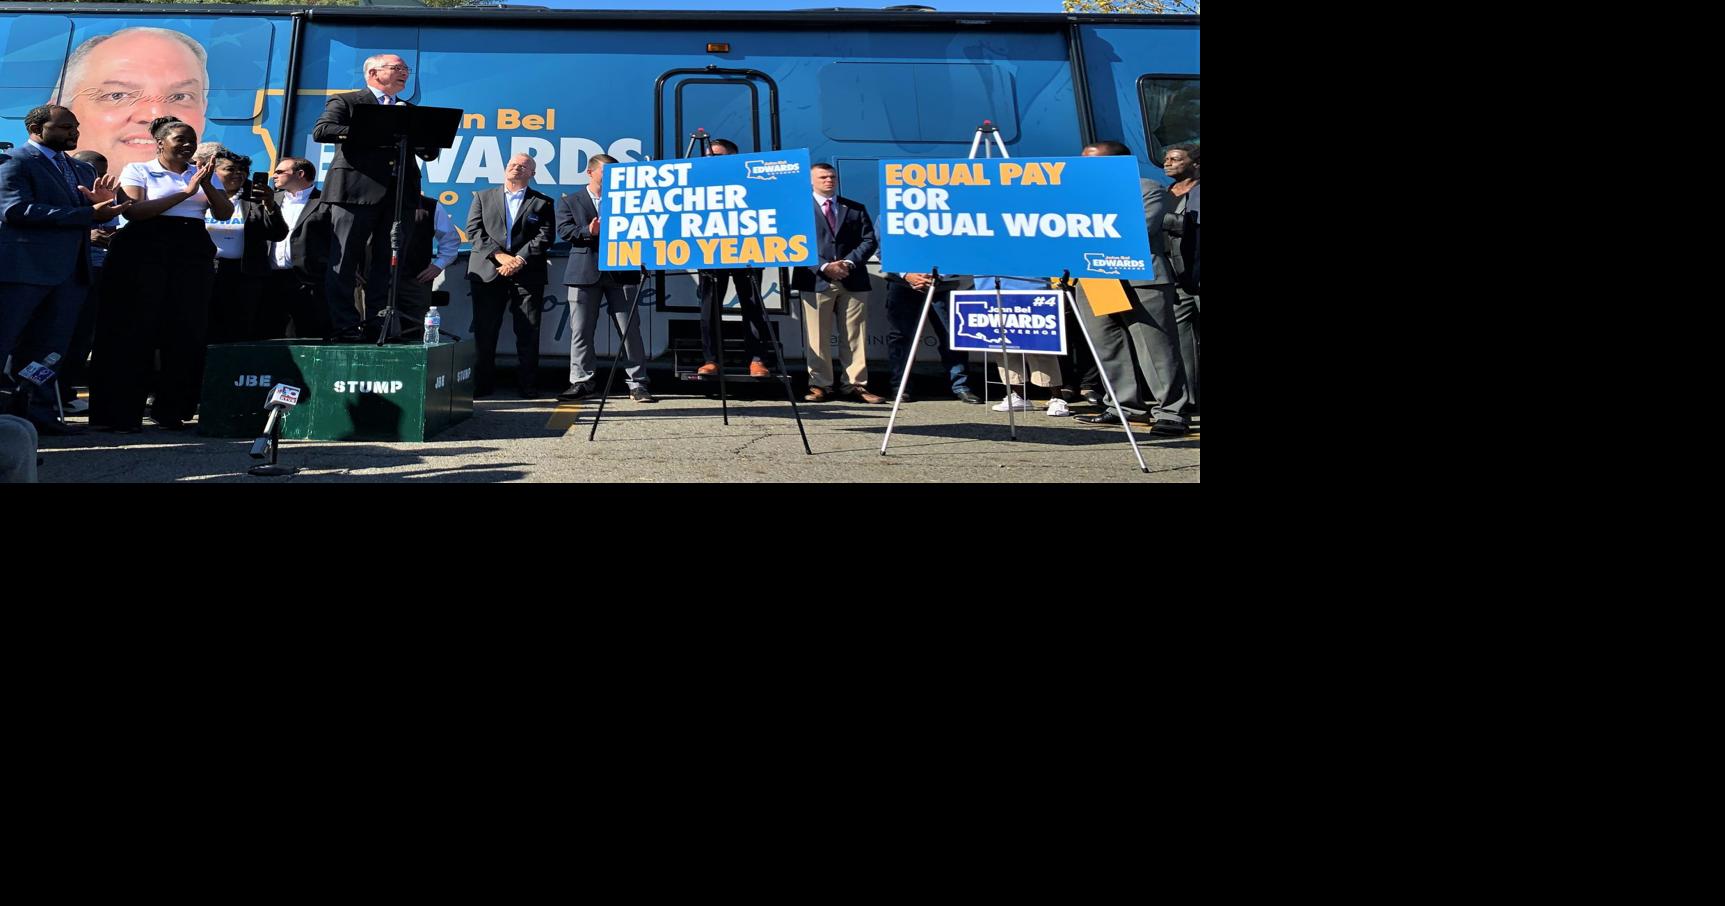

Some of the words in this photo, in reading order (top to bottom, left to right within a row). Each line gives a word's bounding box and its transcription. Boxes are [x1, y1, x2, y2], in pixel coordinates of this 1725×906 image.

[497, 108, 555, 130] Bel
[610, 163, 692, 190] FIRST
[753, 163, 799, 173] EDWARDS
[885, 163, 991, 188] EQUAL
[999, 162, 1066, 186] PAY
[608, 184, 748, 214] TEACHER
[886, 188, 951, 210] FOR
[608, 214, 669, 240] PAY
[681, 208, 778, 238] RAISE
[887, 212, 995, 238] EQUAL
[1001, 213, 1122, 238] WORK
[607, 241, 642, 267] IN
[653, 240, 691, 266] 10
[696, 235, 809, 265] YEARS
[1092, 259, 1145, 268] EDWARDS
[1014, 306, 1031, 314] Bel
[1032, 296, 1056, 307] #4
[968, 313, 1057, 330] EDWARDS
[234, 374, 272, 387] JBE
[333, 380, 403, 395] STUMP
